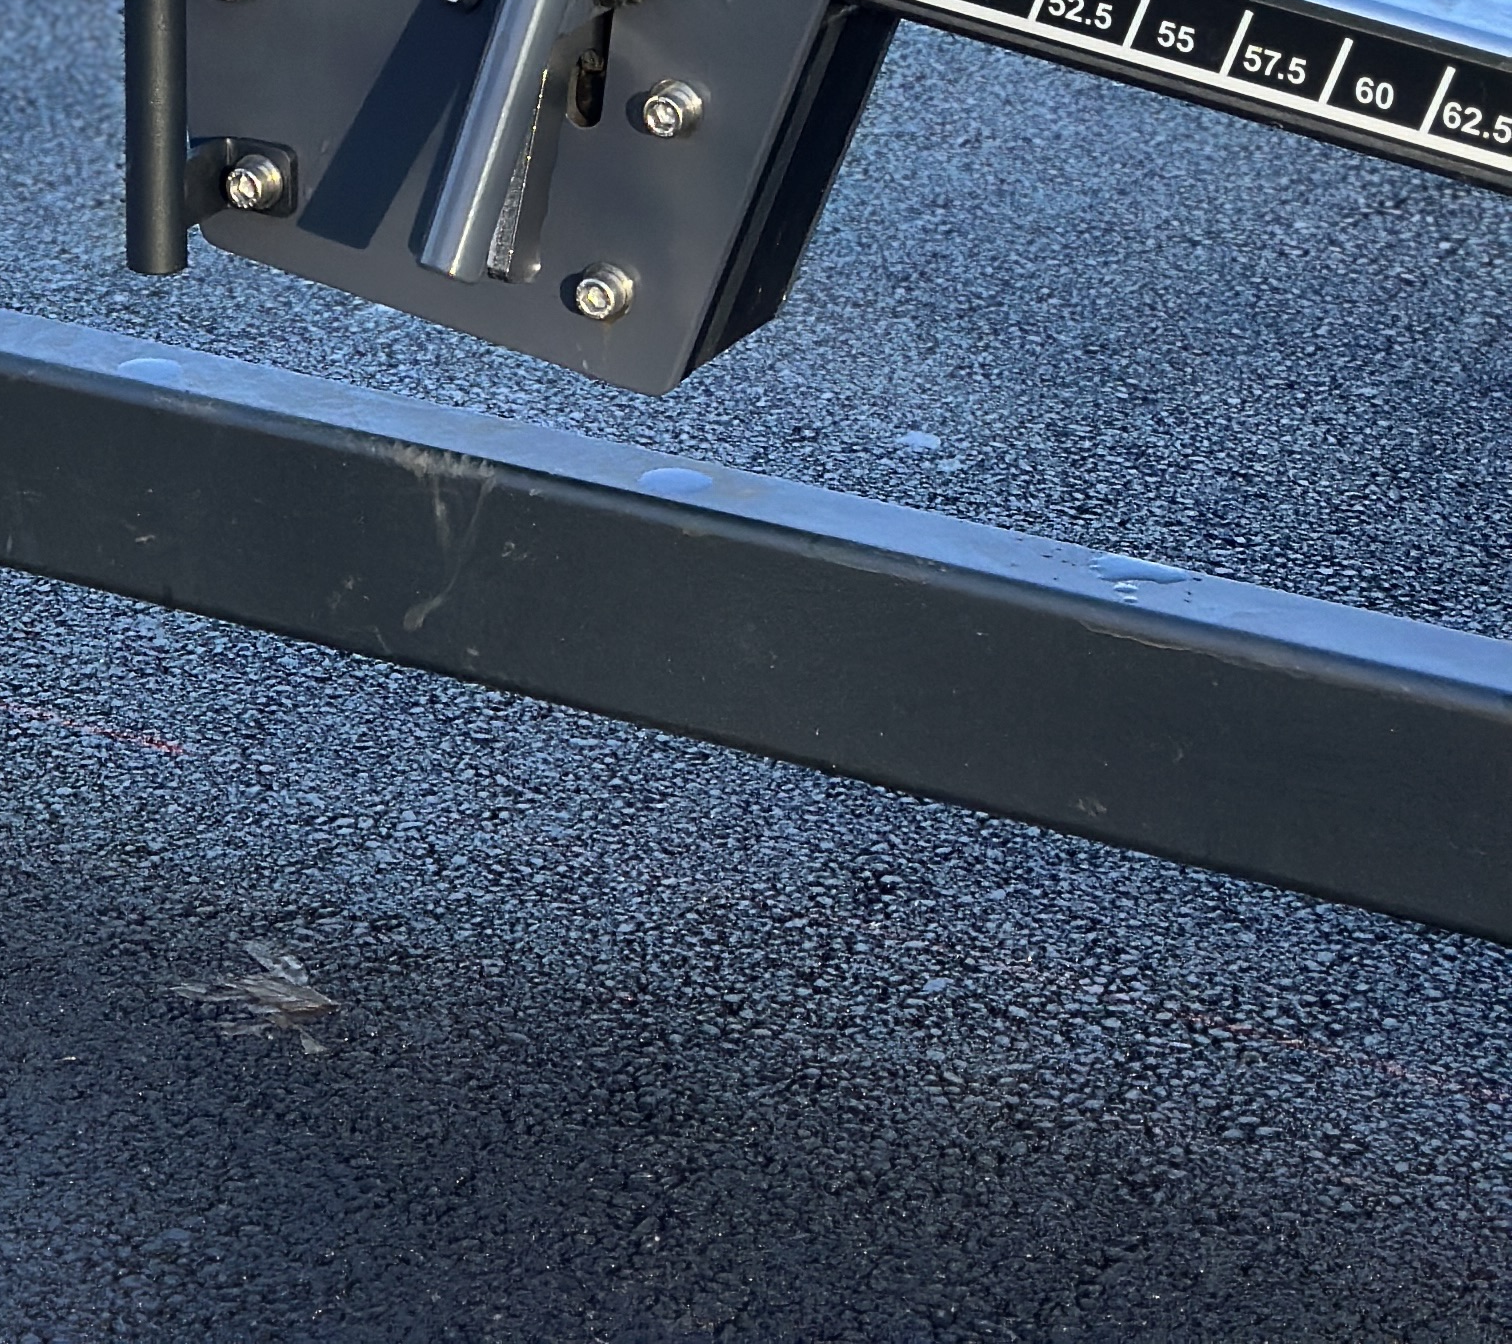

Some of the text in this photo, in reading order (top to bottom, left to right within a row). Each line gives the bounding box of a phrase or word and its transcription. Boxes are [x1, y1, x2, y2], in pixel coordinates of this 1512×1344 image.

[1156, 20, 1196, 53] 55
[1242, 44, 1307, 85] 57.5
[1355, 76, 1395, 110] 60
[1442, 101, 1512, 144] 62.5
